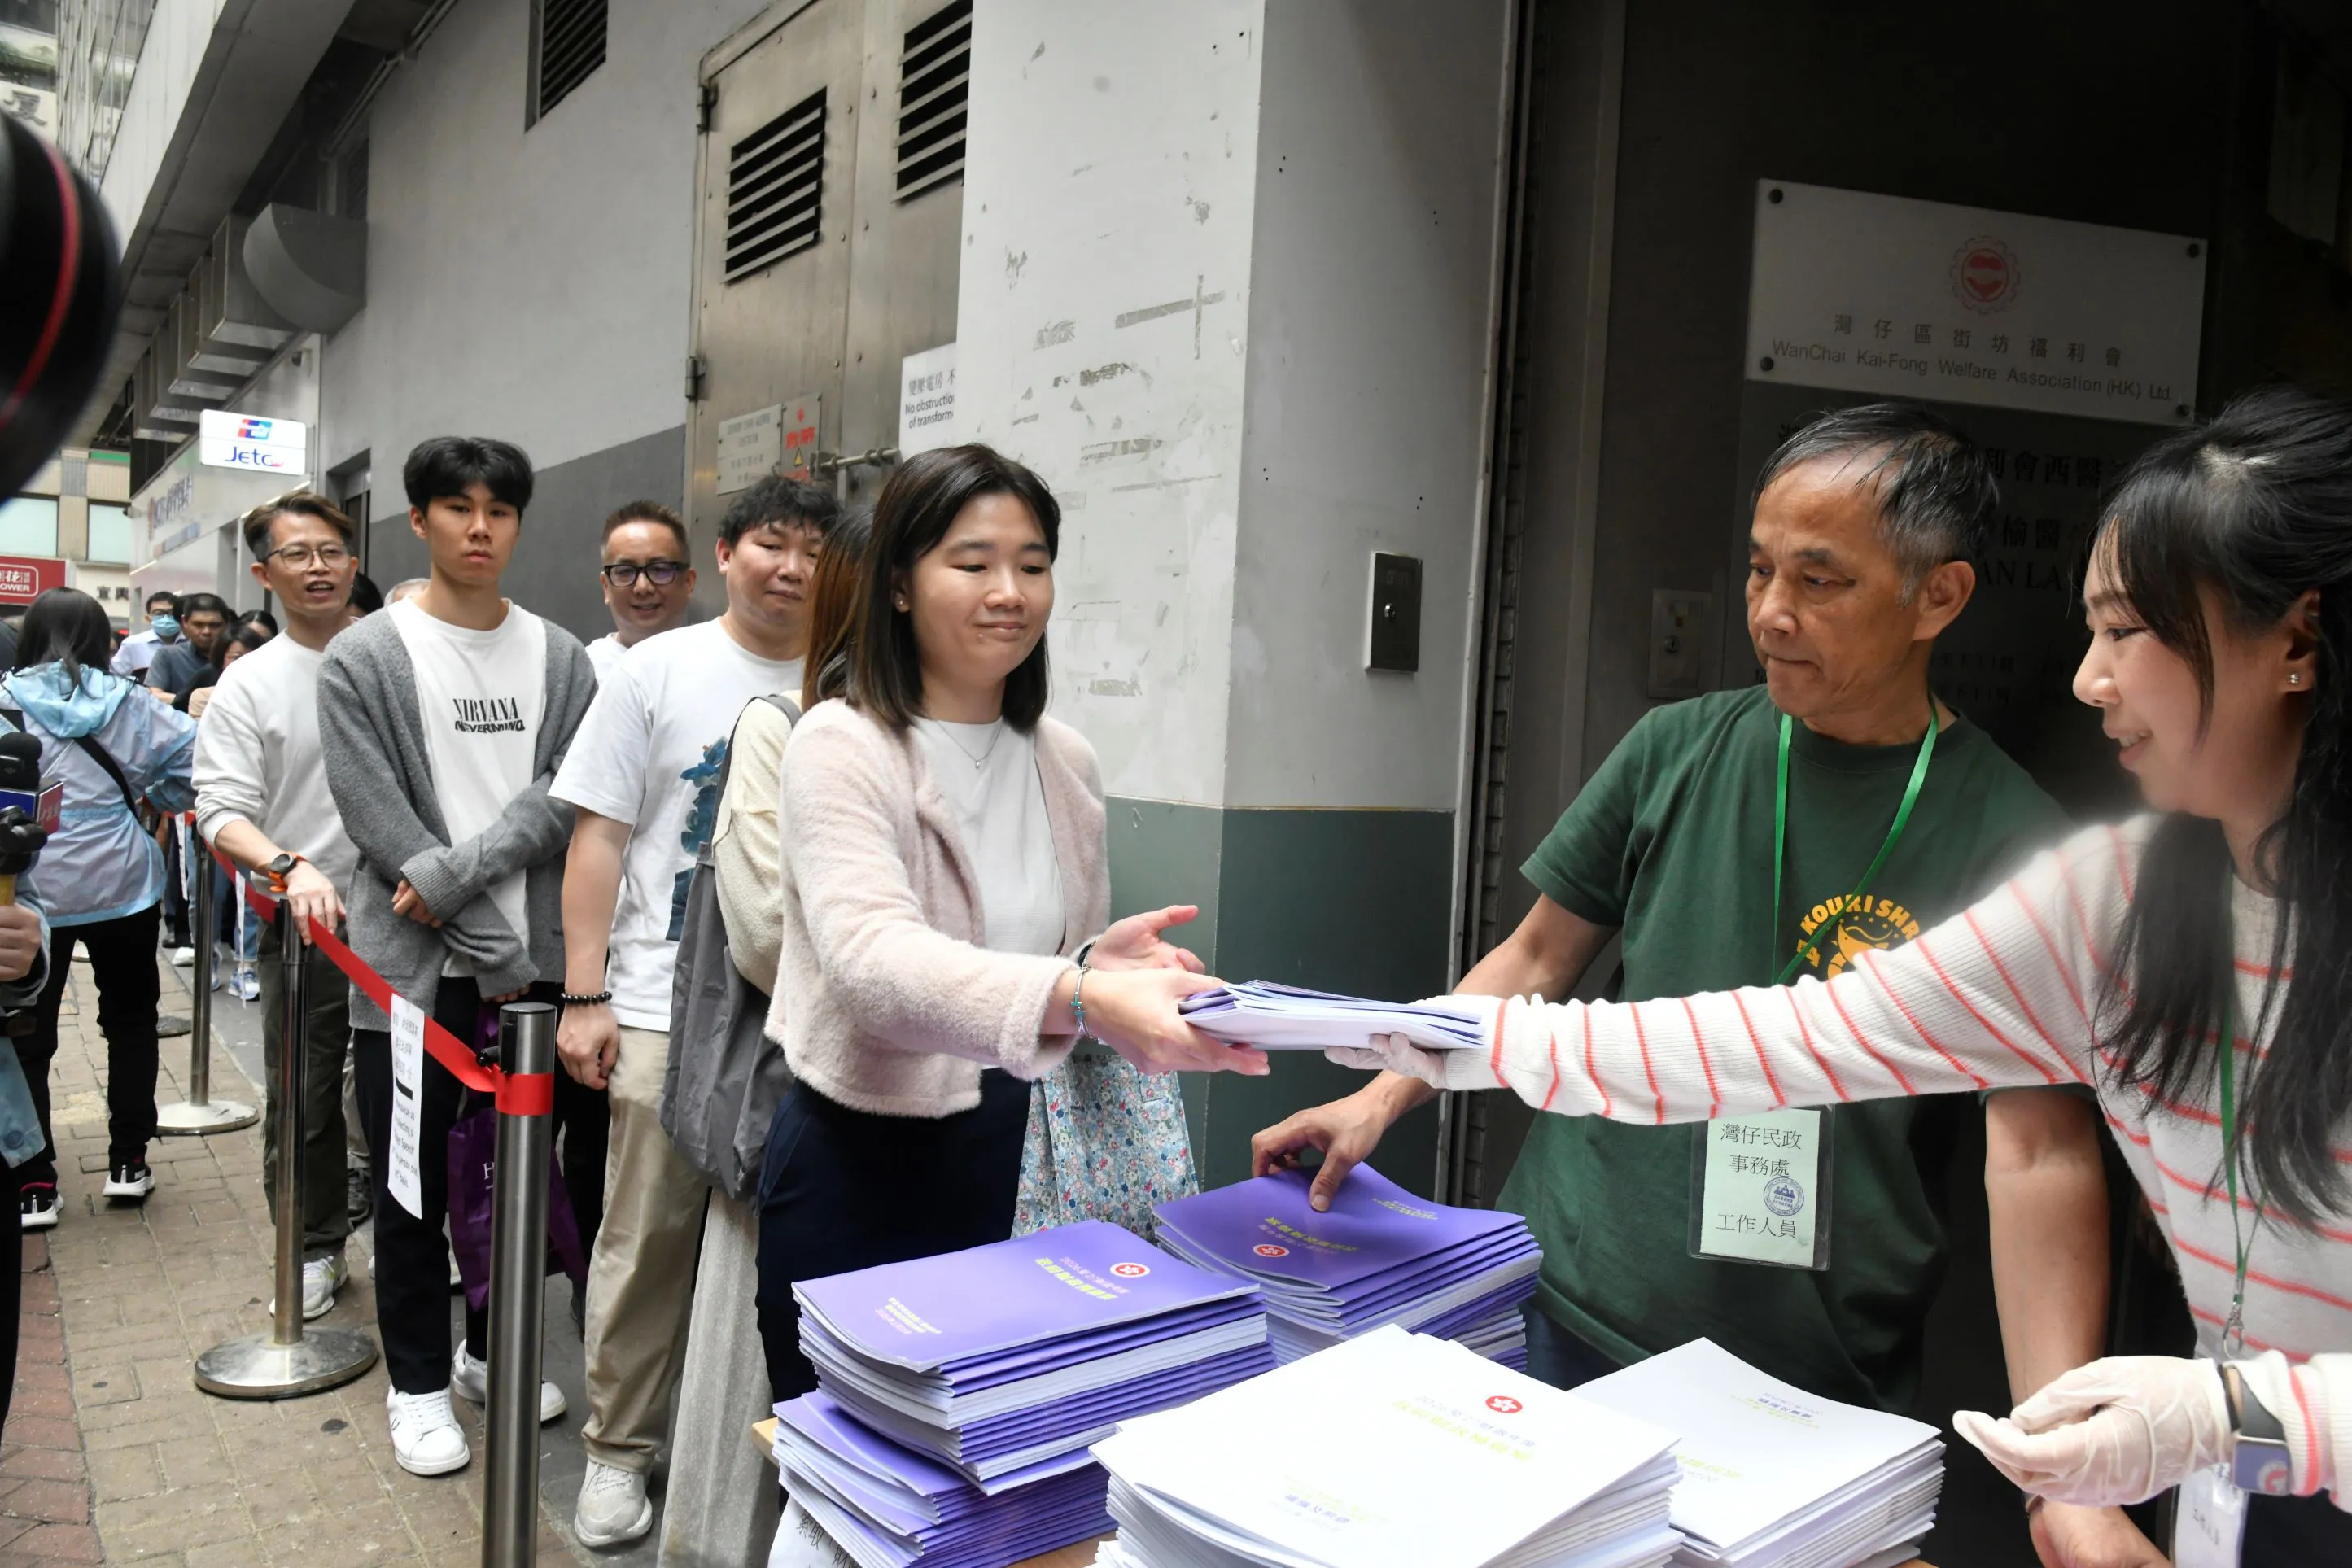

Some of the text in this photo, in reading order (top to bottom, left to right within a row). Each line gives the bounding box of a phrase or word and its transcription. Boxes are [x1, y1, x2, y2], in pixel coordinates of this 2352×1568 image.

[1834, 313, 2122, 369] 灣仔區街坊福利會
[1771, 338, 1846, 365] WanChai
[1856, 348, 1928, 377] Kai-Fong
[1939, 358, 1997, 382] Welfare
[2006, 366, 2101, 394] Association
[905, 393, 955, 416] No obstructio
[908, 409, 954, 430] of transform
[0, 583, 30, 592] OWER
[452, 697, 520, 723] NIRVANA
[1875, 898, 1921, 941] SHR
[1720, 1122, 1802, 1150] 灣仔民政
[1729, 1153, 1790, 1179] 事務處
[1716, 1213, 1797, 1239] 工作人員
